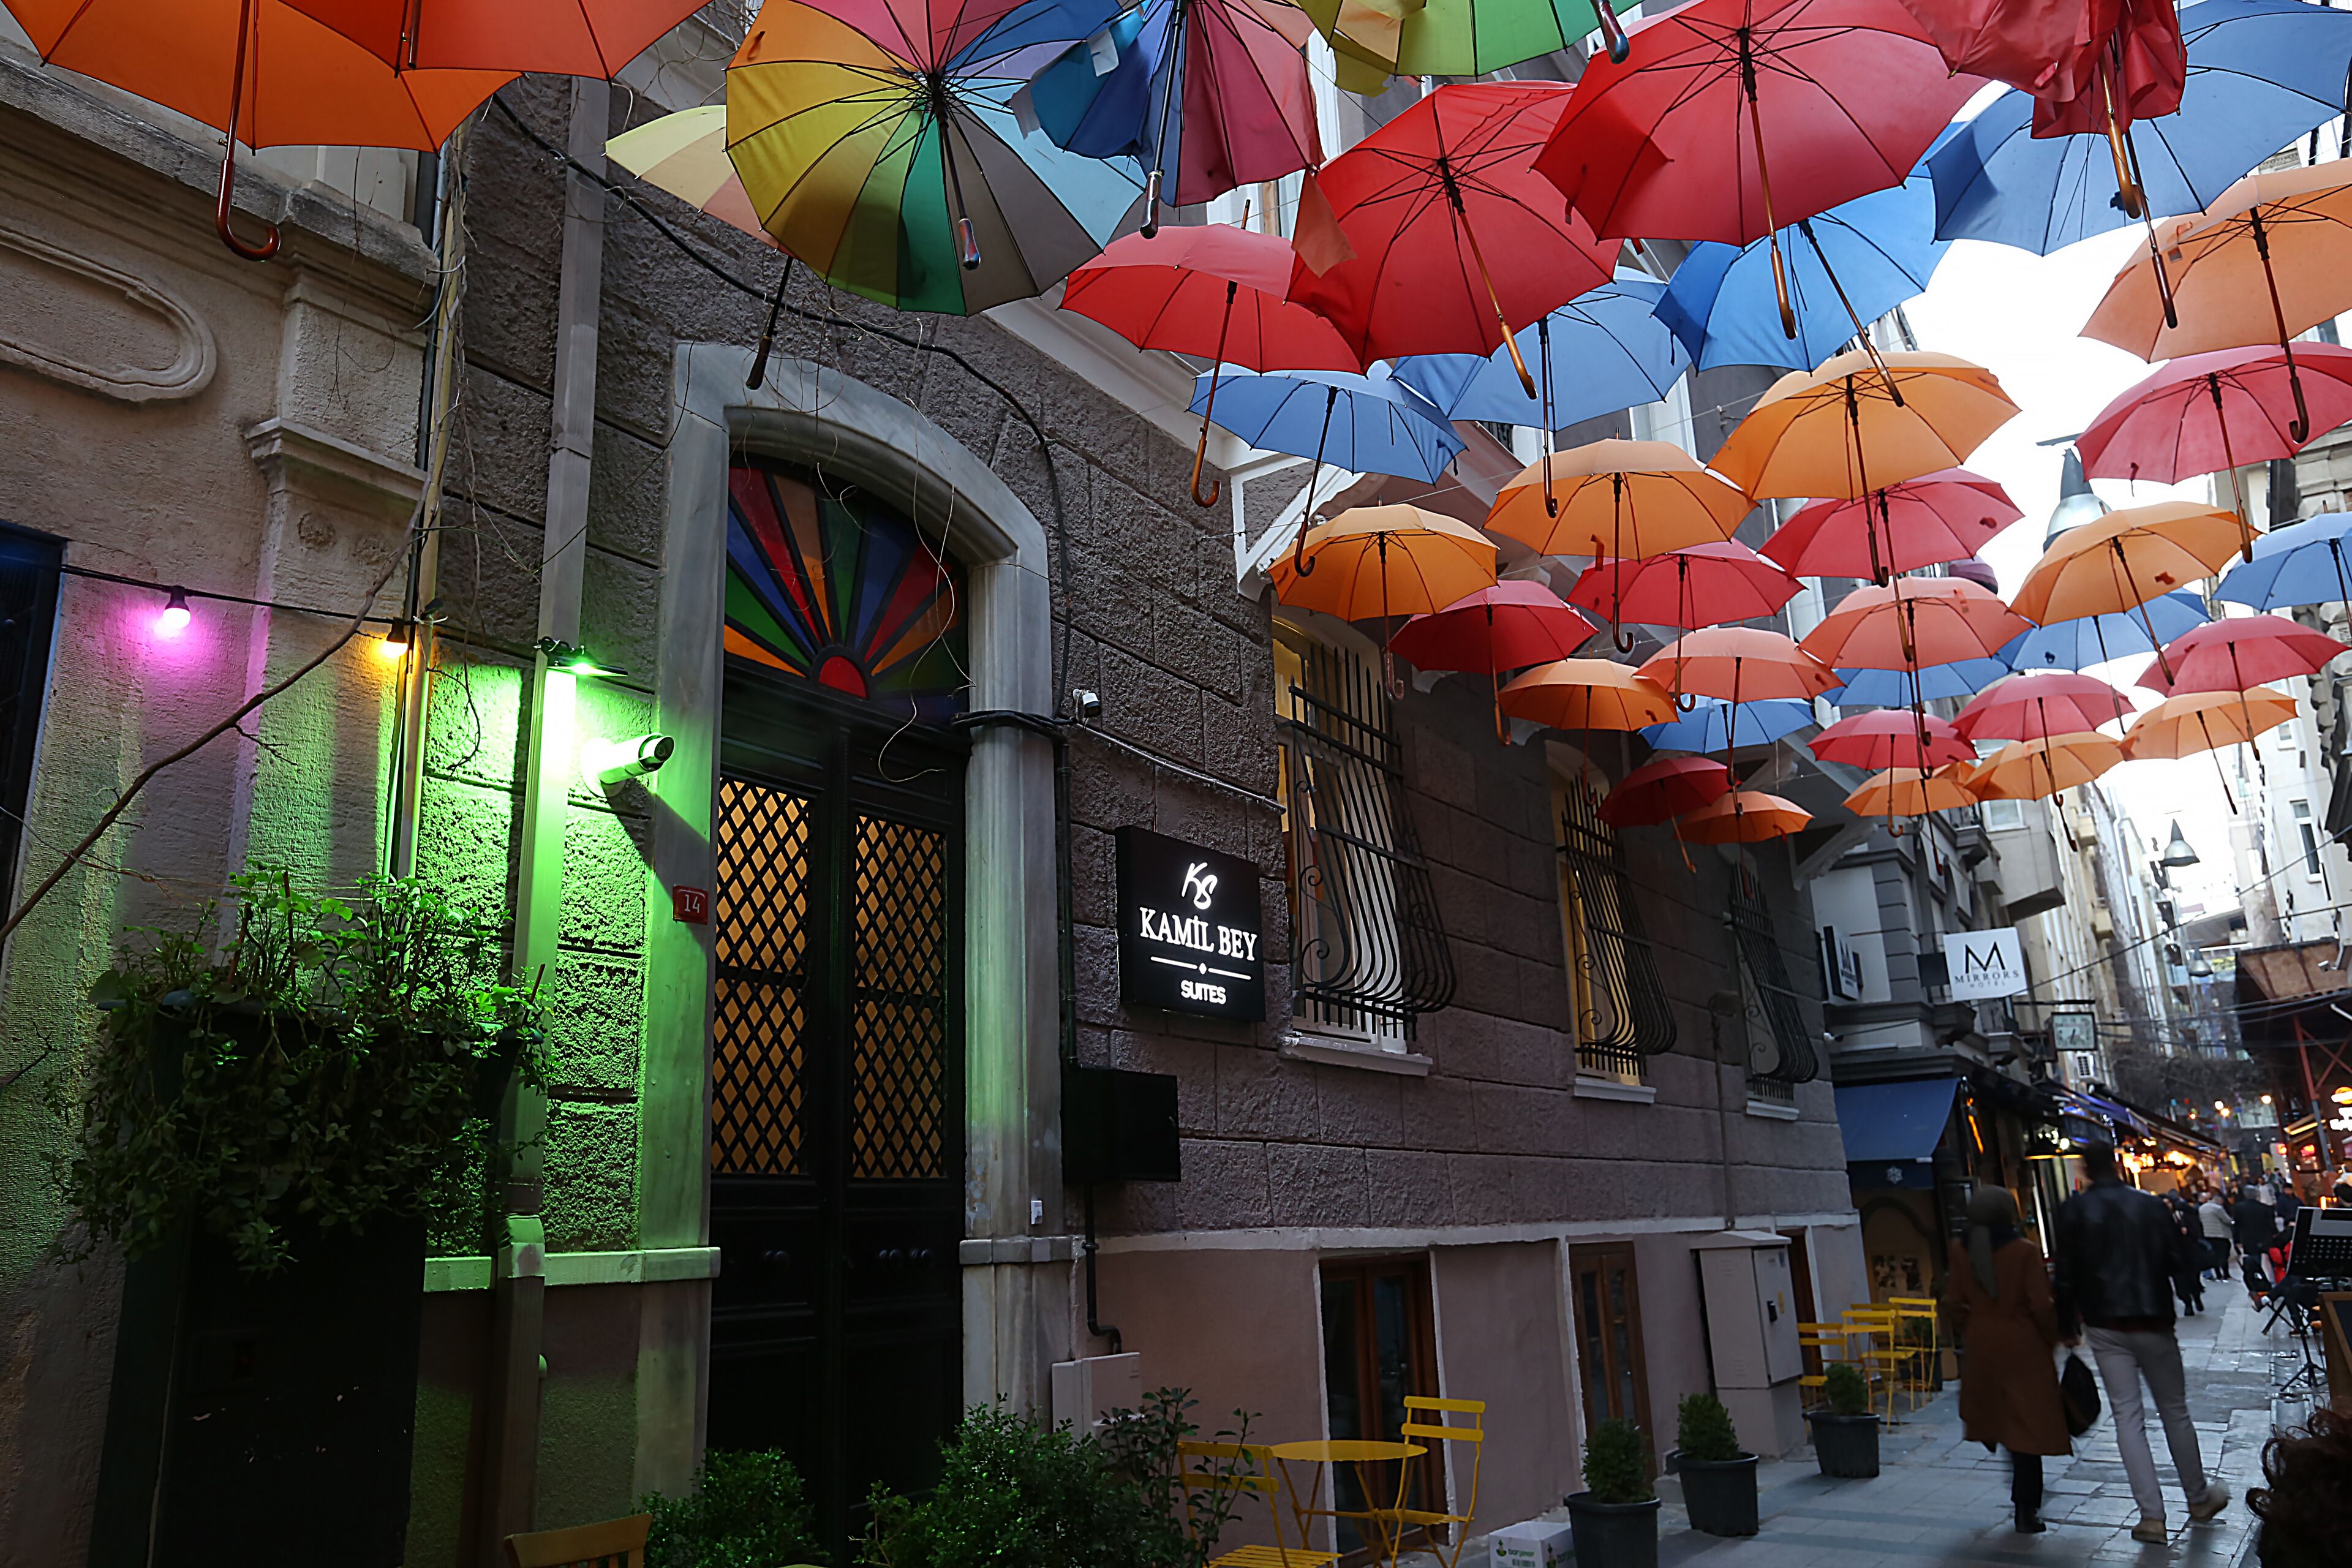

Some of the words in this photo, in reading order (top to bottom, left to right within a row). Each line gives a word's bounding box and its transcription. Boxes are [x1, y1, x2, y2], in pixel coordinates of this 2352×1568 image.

[685, 894, 700, 913] 14
[1217, 925, 1257, 961] BEY
[1954, 970, 2019, 983] MIRRORS
[1180, 979, 1227, 1005] SUITES
